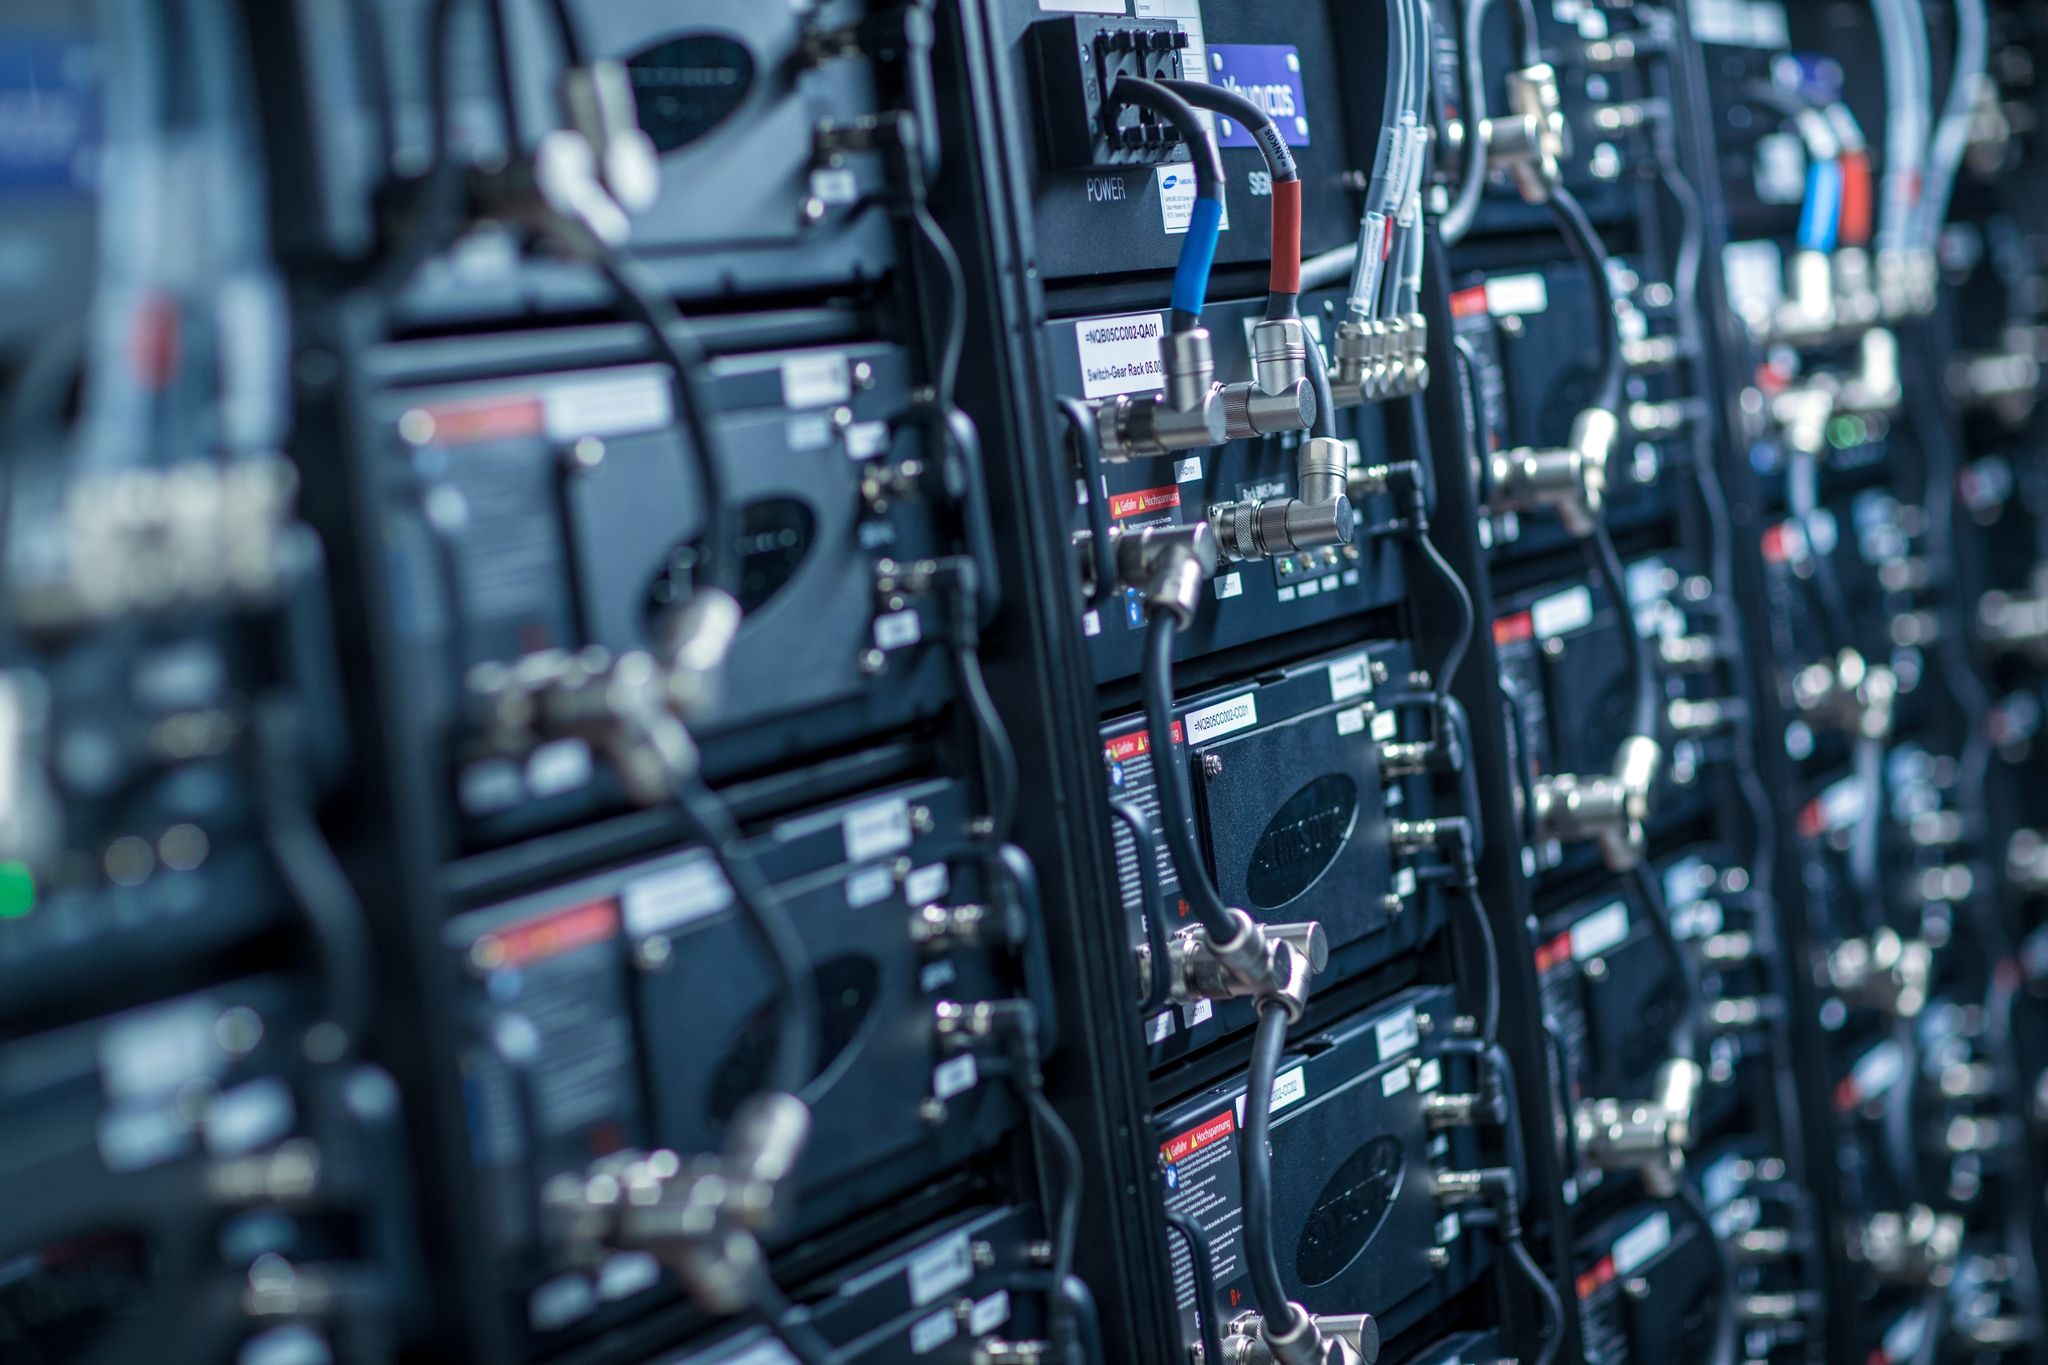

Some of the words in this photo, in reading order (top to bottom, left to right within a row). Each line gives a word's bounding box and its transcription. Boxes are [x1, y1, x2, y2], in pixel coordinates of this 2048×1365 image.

[1086, 177, 1126, 202] POWER
[1085, 323, 1158, 343] =NQB05CC002-QA01
[1087, 365, 1127, 382] Switch-Gear
[1127, 362, 1145, 377] Rack
[1120, 498, 1137, 512] Gefahr
[1144, 492, 1179, 507] Hochspannung
[1170, 1141, 1188, 1157] Gefahr
[1196, 1119, 1231, 1143] Hochspannung
[1230, 1289, 1241, 1306] B+
